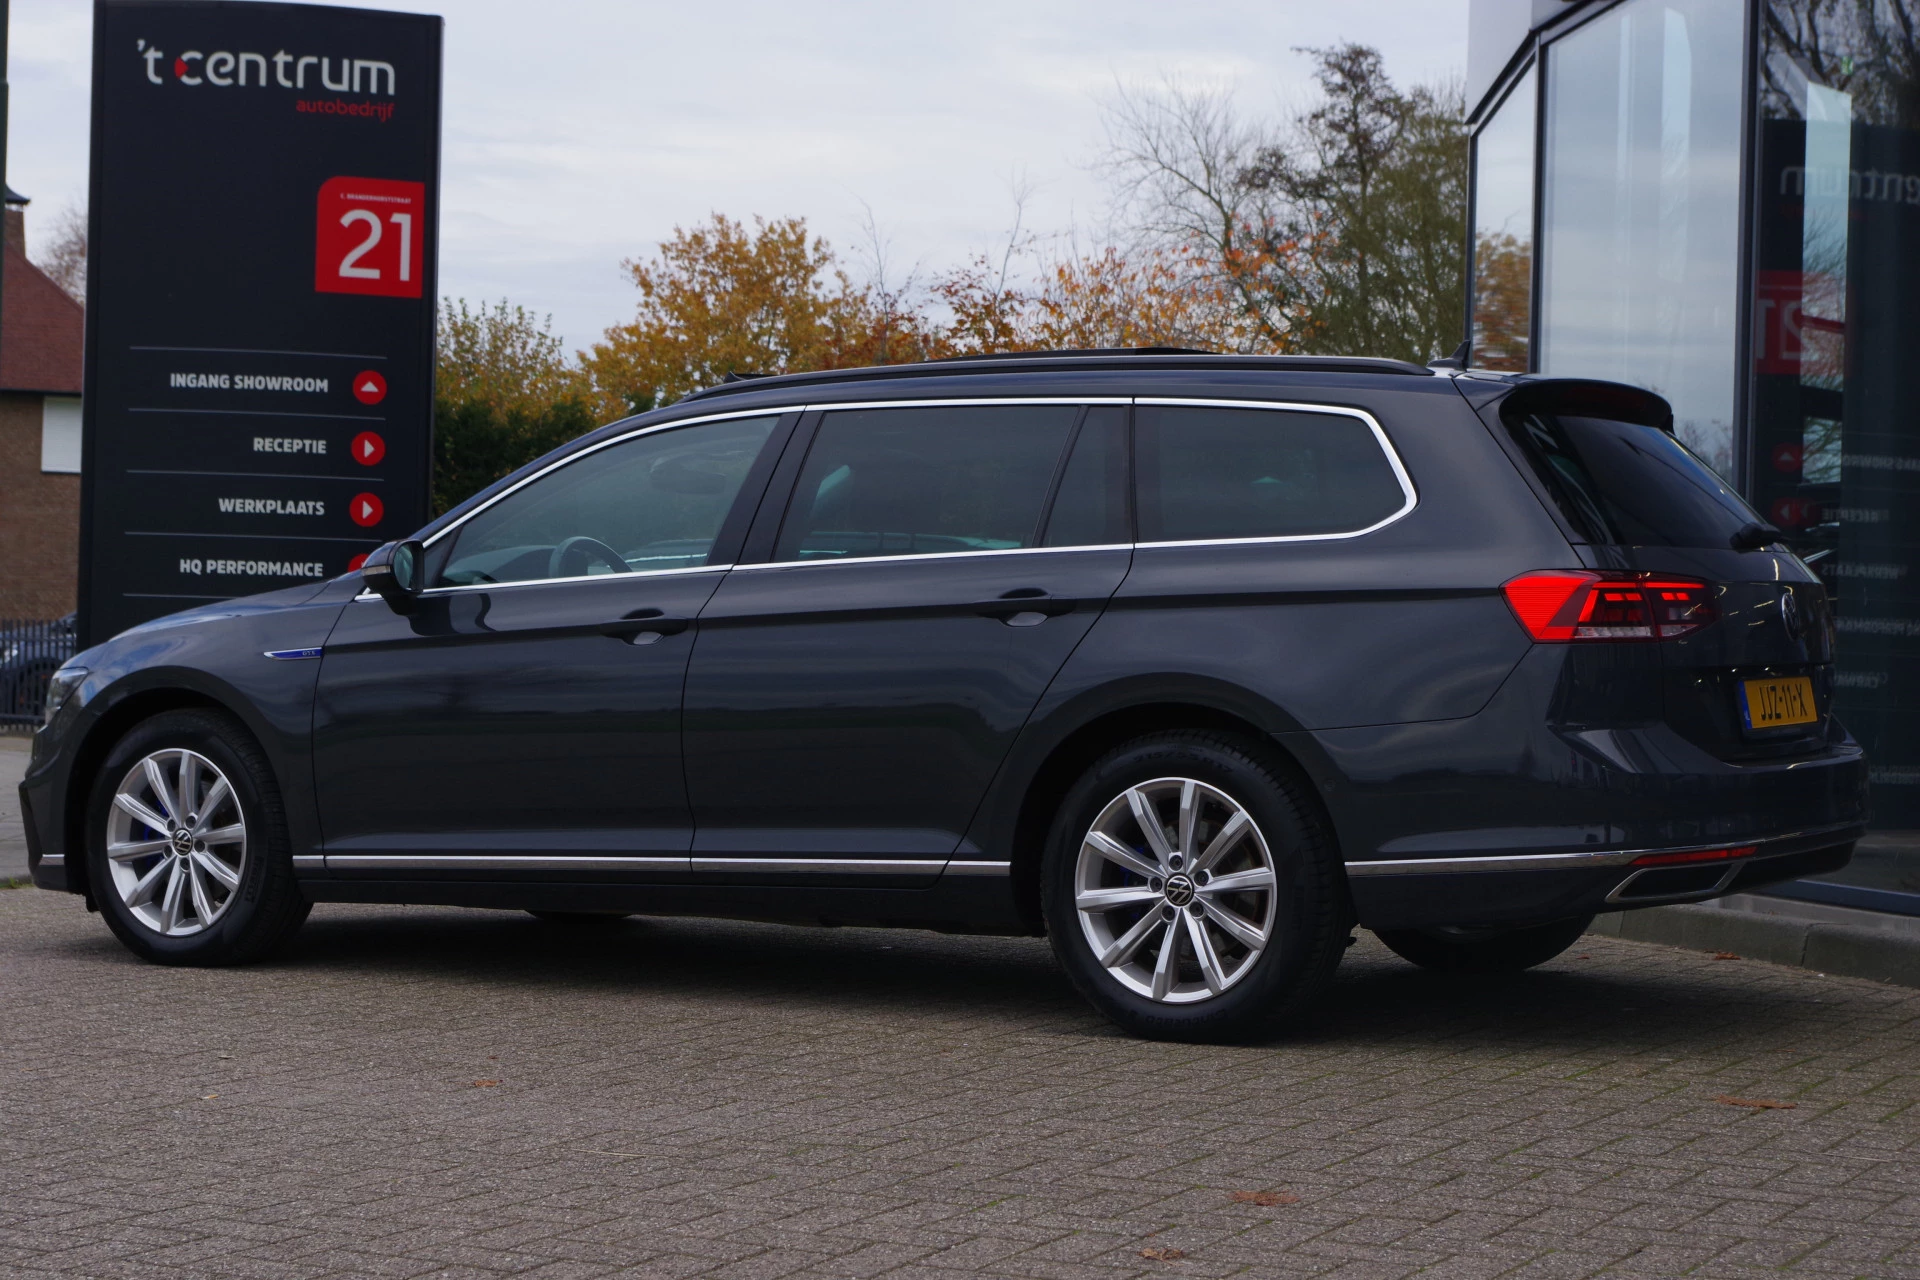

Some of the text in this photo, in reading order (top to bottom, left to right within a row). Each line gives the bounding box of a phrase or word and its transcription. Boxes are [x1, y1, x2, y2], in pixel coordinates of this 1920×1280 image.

[137, 39, 396, 96] 't centrum
[296, 99, 395, 123] autobedrijf
[338, 208, 412, 282] 21
[170, 373, 329, 393] INGANG SHOWROOM
[253, 437, 327, 454] RECEPTIE
[218, 498, 325, 516] WERKPLAATS
[179, 558, 324, 577] HQ PERFORMANCE
